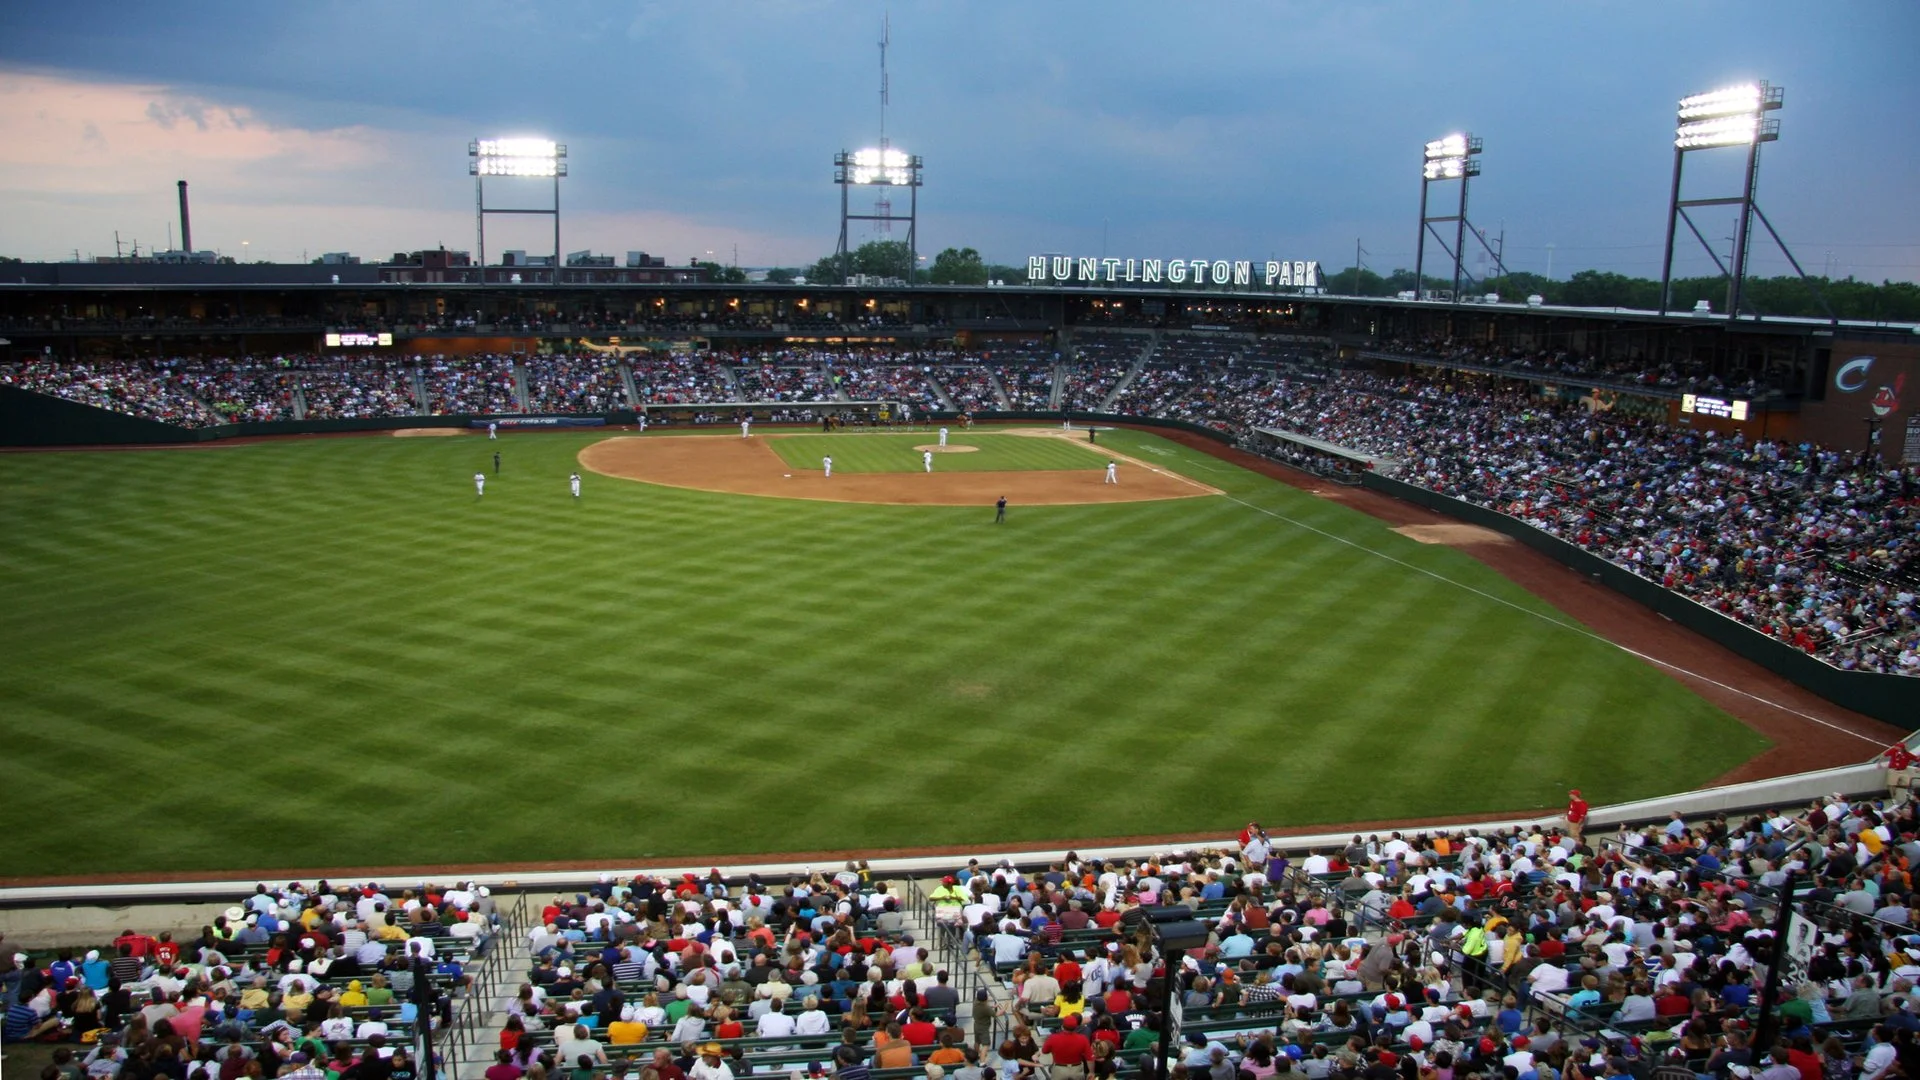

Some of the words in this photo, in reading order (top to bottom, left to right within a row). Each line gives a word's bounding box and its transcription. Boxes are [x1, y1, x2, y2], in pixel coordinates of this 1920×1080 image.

[1028, 256, 1250, 285] HUNTINGTON
[1266, 261, 1318, 286] PARK
[1786, 961, 1809, 987] 29
